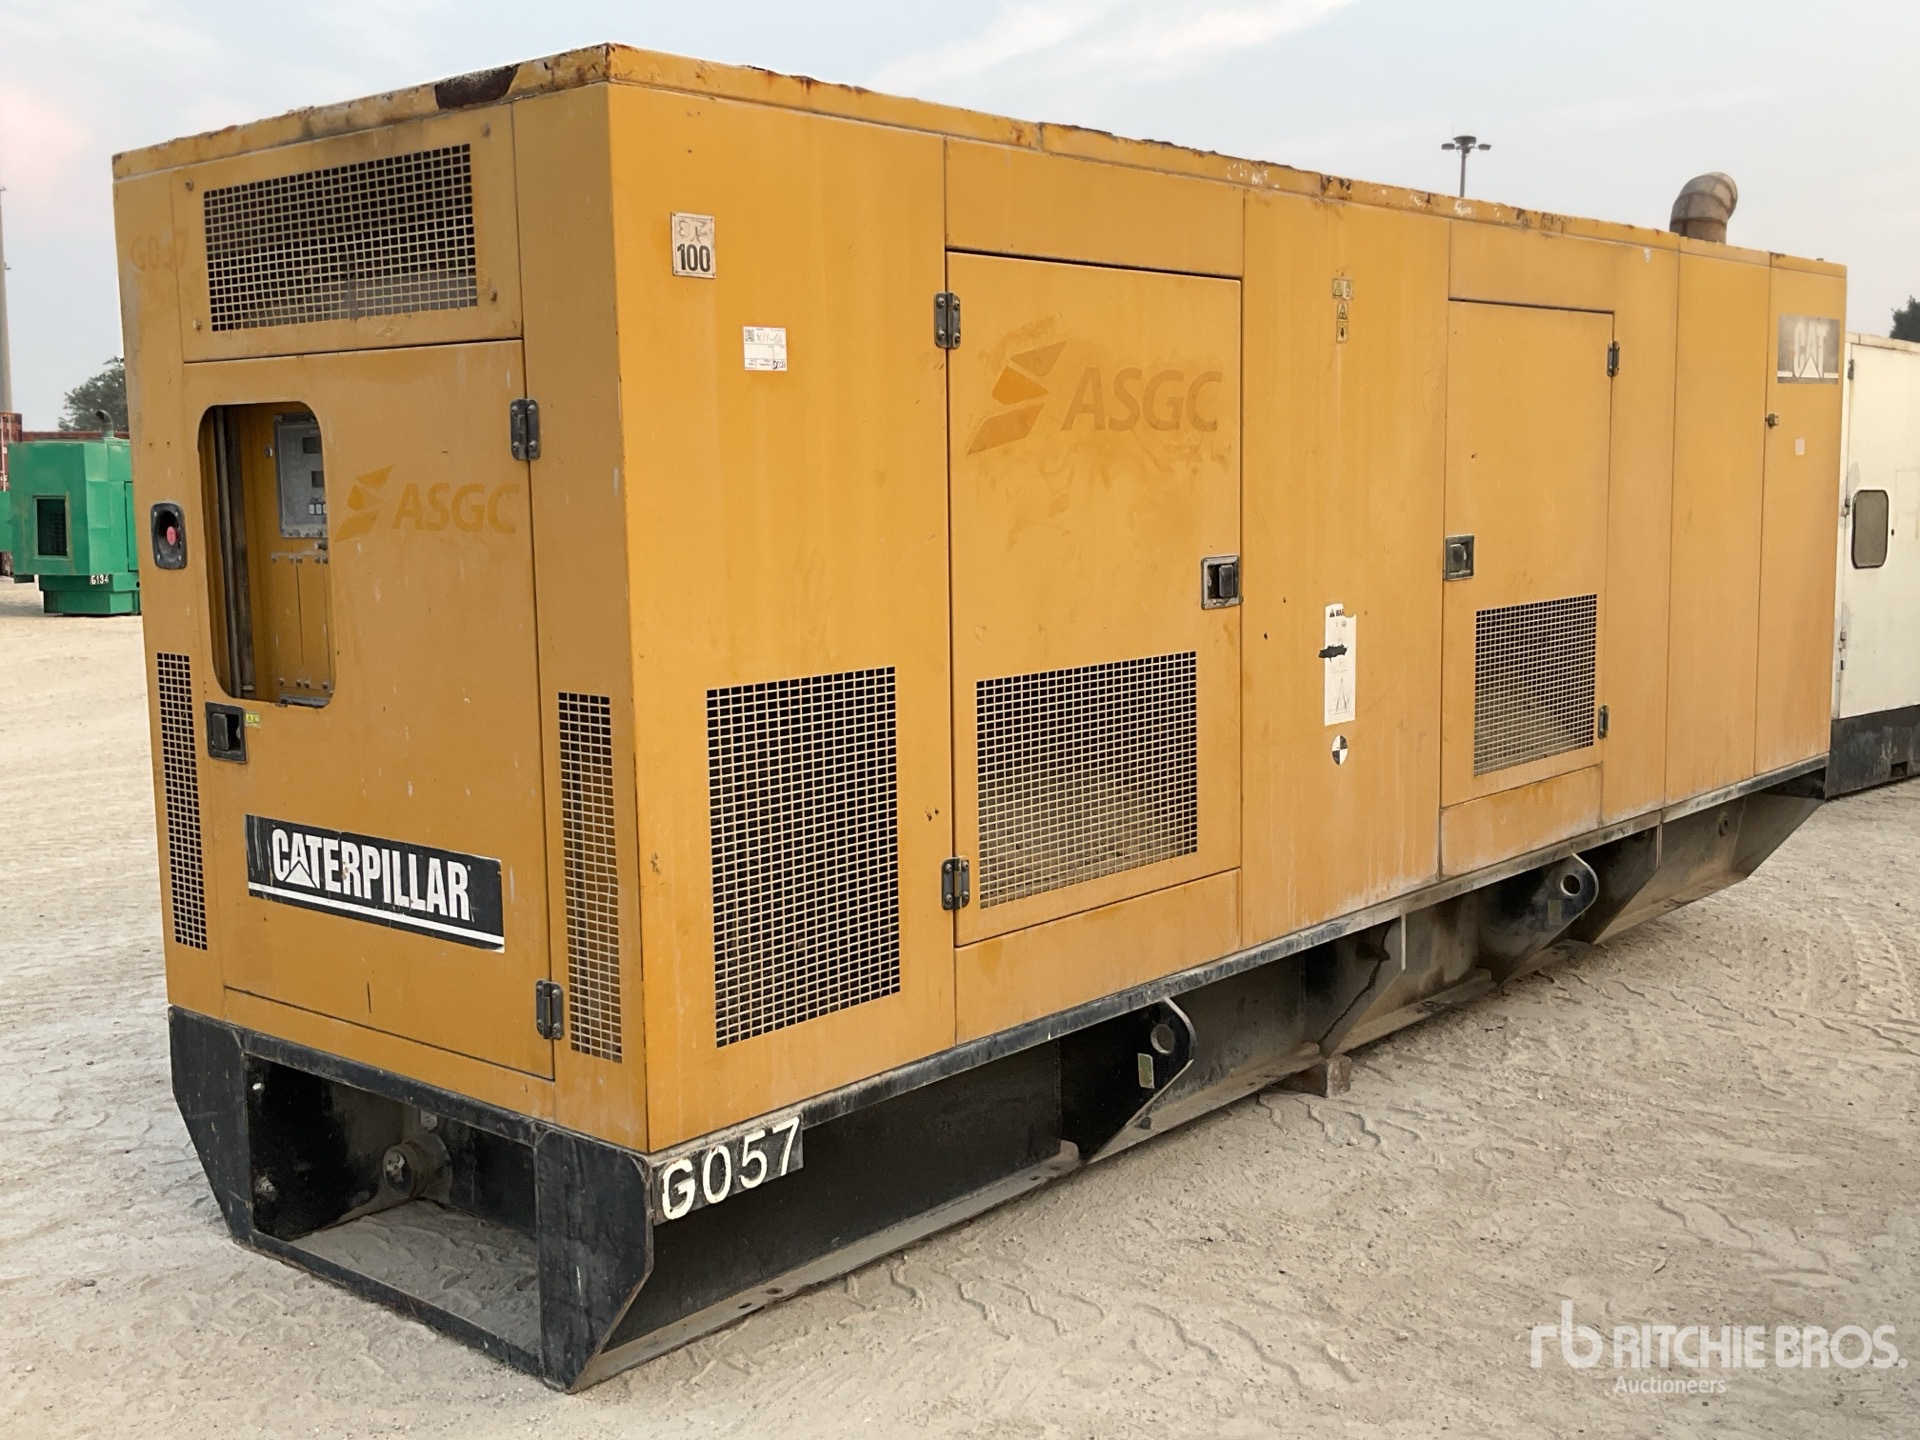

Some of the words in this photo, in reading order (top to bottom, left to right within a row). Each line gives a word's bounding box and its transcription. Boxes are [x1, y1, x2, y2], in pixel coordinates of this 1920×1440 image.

[677, 243, 711, 272] 100
[1793, 317, 1829, 378] CAT
[1060, 366, 1223, 433] ASGC
[392, 482, 520, 534] ASGC
[271, 828, 471, 921] CATERPILLAR
[662, 1117, 800, 1220] G057
